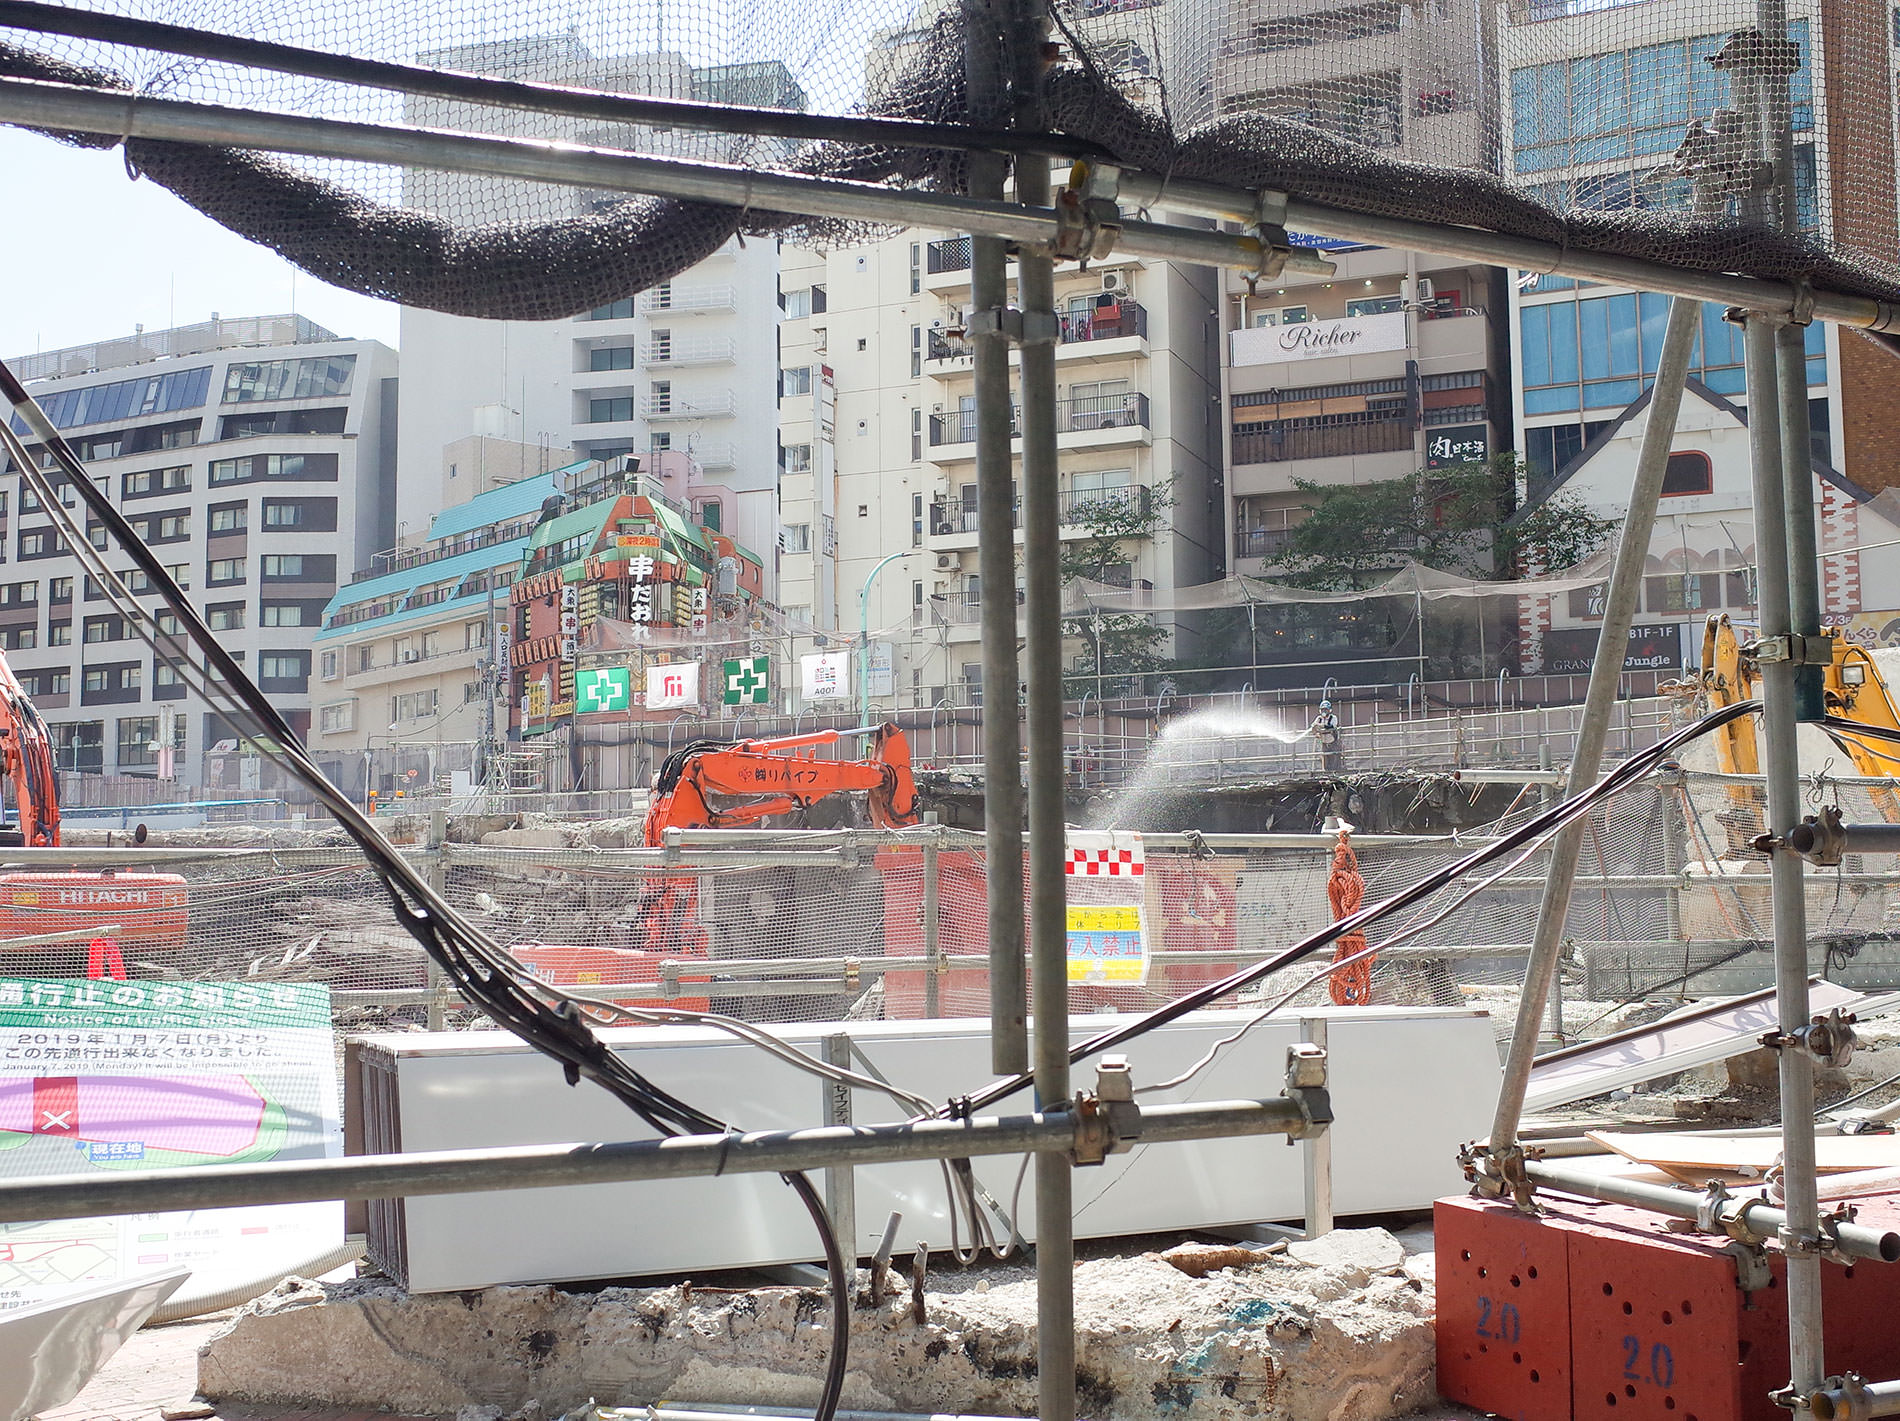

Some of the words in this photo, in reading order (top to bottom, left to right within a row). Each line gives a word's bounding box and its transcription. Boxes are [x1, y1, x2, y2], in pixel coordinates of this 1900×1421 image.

[1279, 323, 1362, 351] Richer
[628, 554, 654, 640] 串だおれ
[1825, 615, 1852, 625] 2/3F
[1629, 627, 1672, 639] B1F-1F
[1625, 656, 1671, 668] Jungle
[60, 890, 148, 903] HITACHI
[44, 1013, 105, 1025] Notice
[112, 1014, 130, 1025] of
[136, 1014, 192, 1026] traffic
[3, 1063, 47, 1071] January
[93, 1062, 142, 1071] (Monday)
[92, 1143, 142, 1154] 現在地
[1476, 1296, 1521, 1344] 2.0
[1622, 1335, 1674, 1389] 2.0
